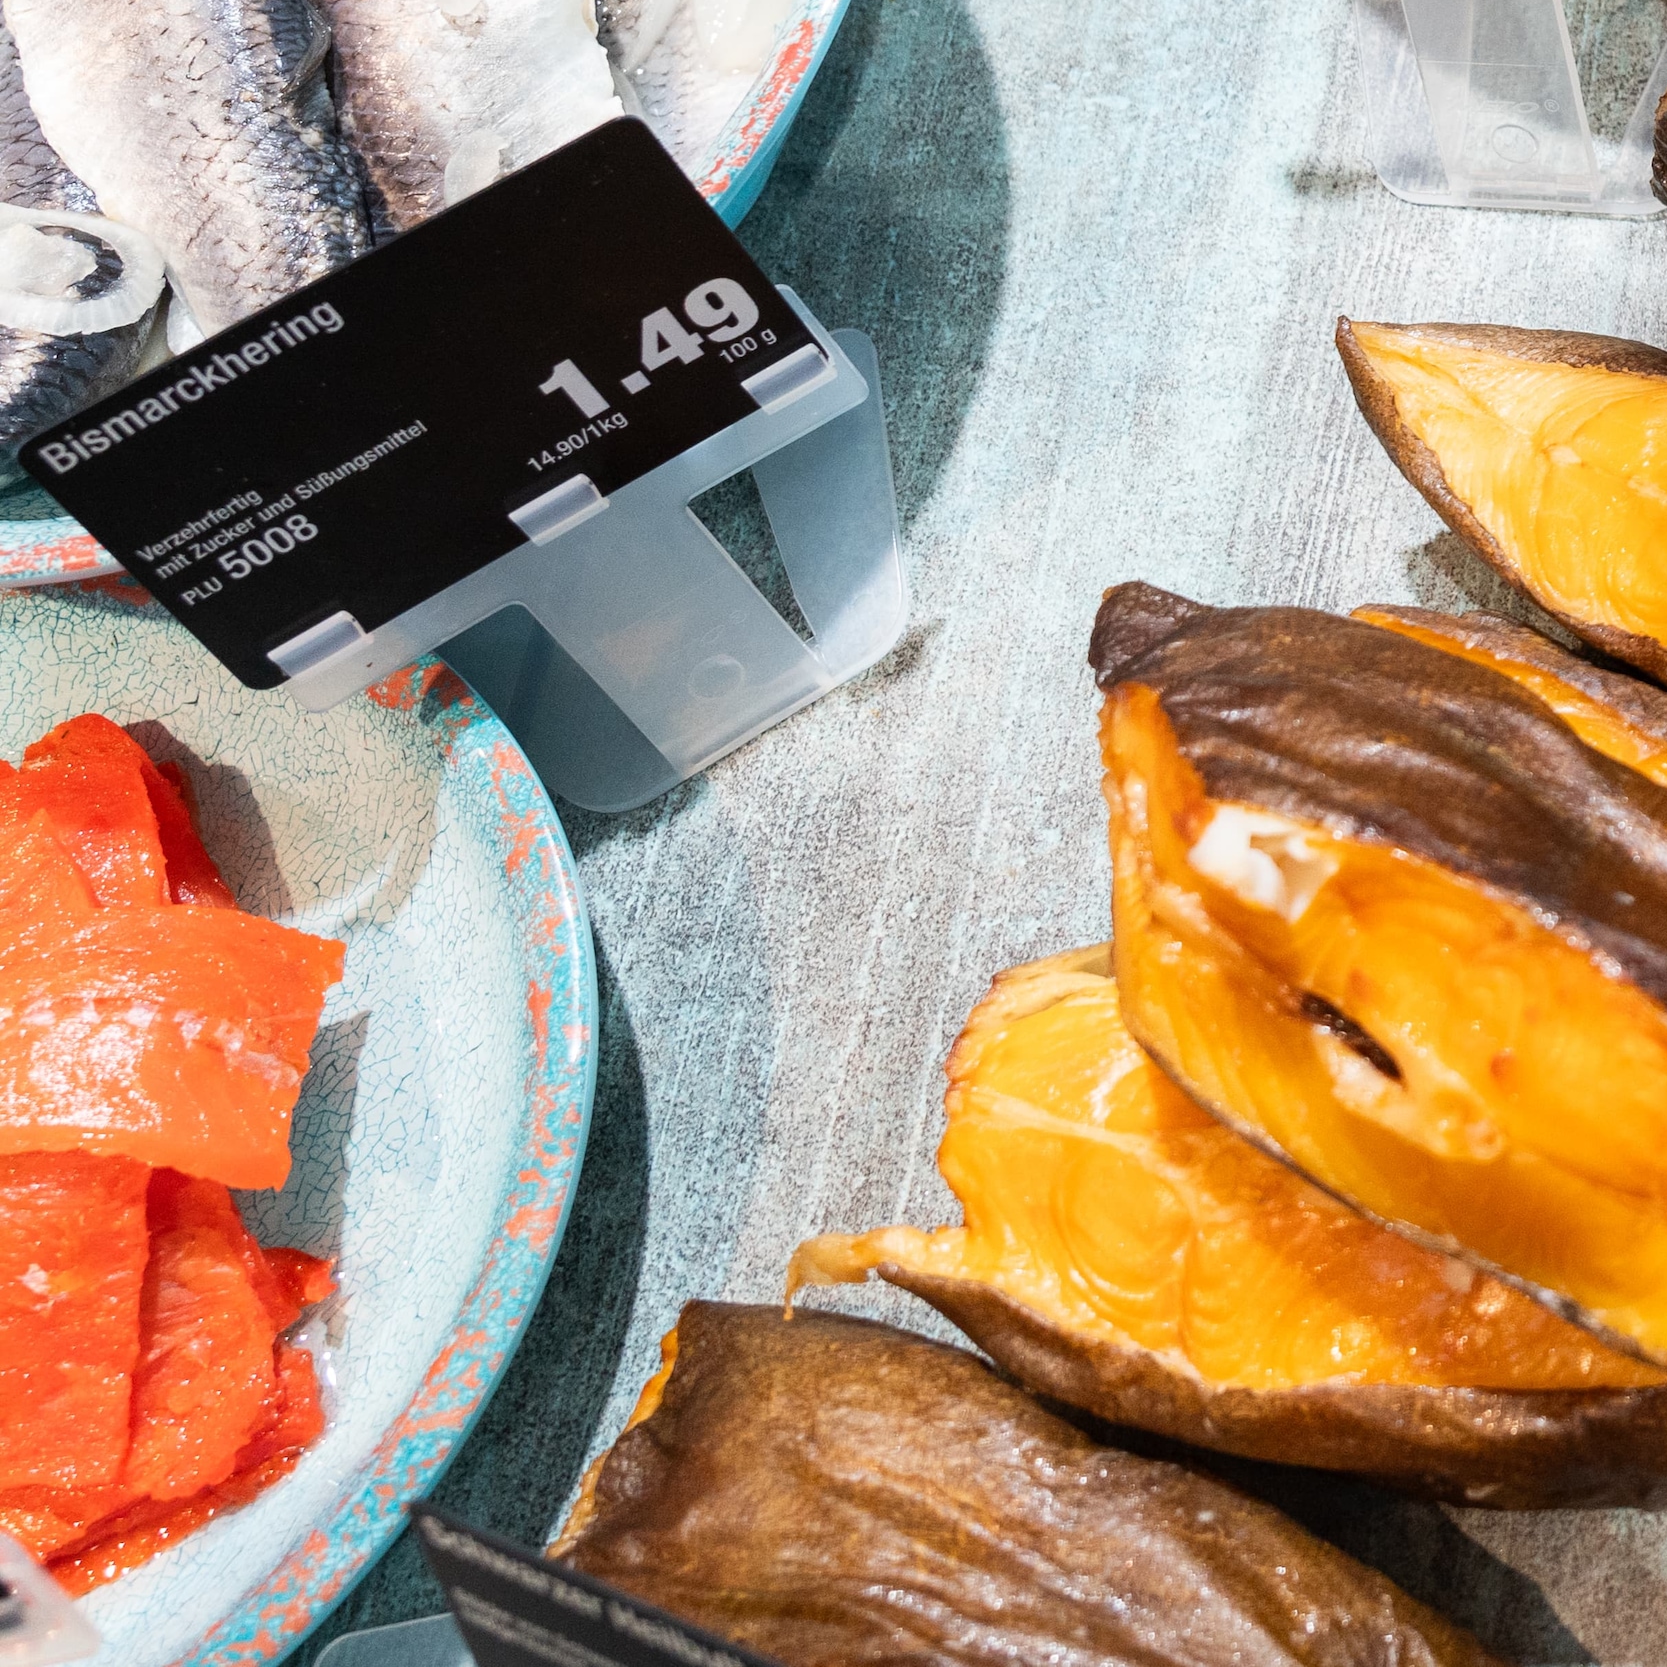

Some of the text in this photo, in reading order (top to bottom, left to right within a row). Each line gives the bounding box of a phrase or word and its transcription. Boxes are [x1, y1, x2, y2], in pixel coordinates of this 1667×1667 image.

[38, 302, 345, 474] Bismarckhering
[544, 277, 760, 419] 1.49
[719, 328, 778, 363] 100 g
[527, 412, 629, 472] 14.90/1kg
[136, 490, 263, 562] Verzehrfertig
[156, 419, 428, 579] mit Zucker und Süßungsmittel
[181, 514, 319, 606] PLU 5008
